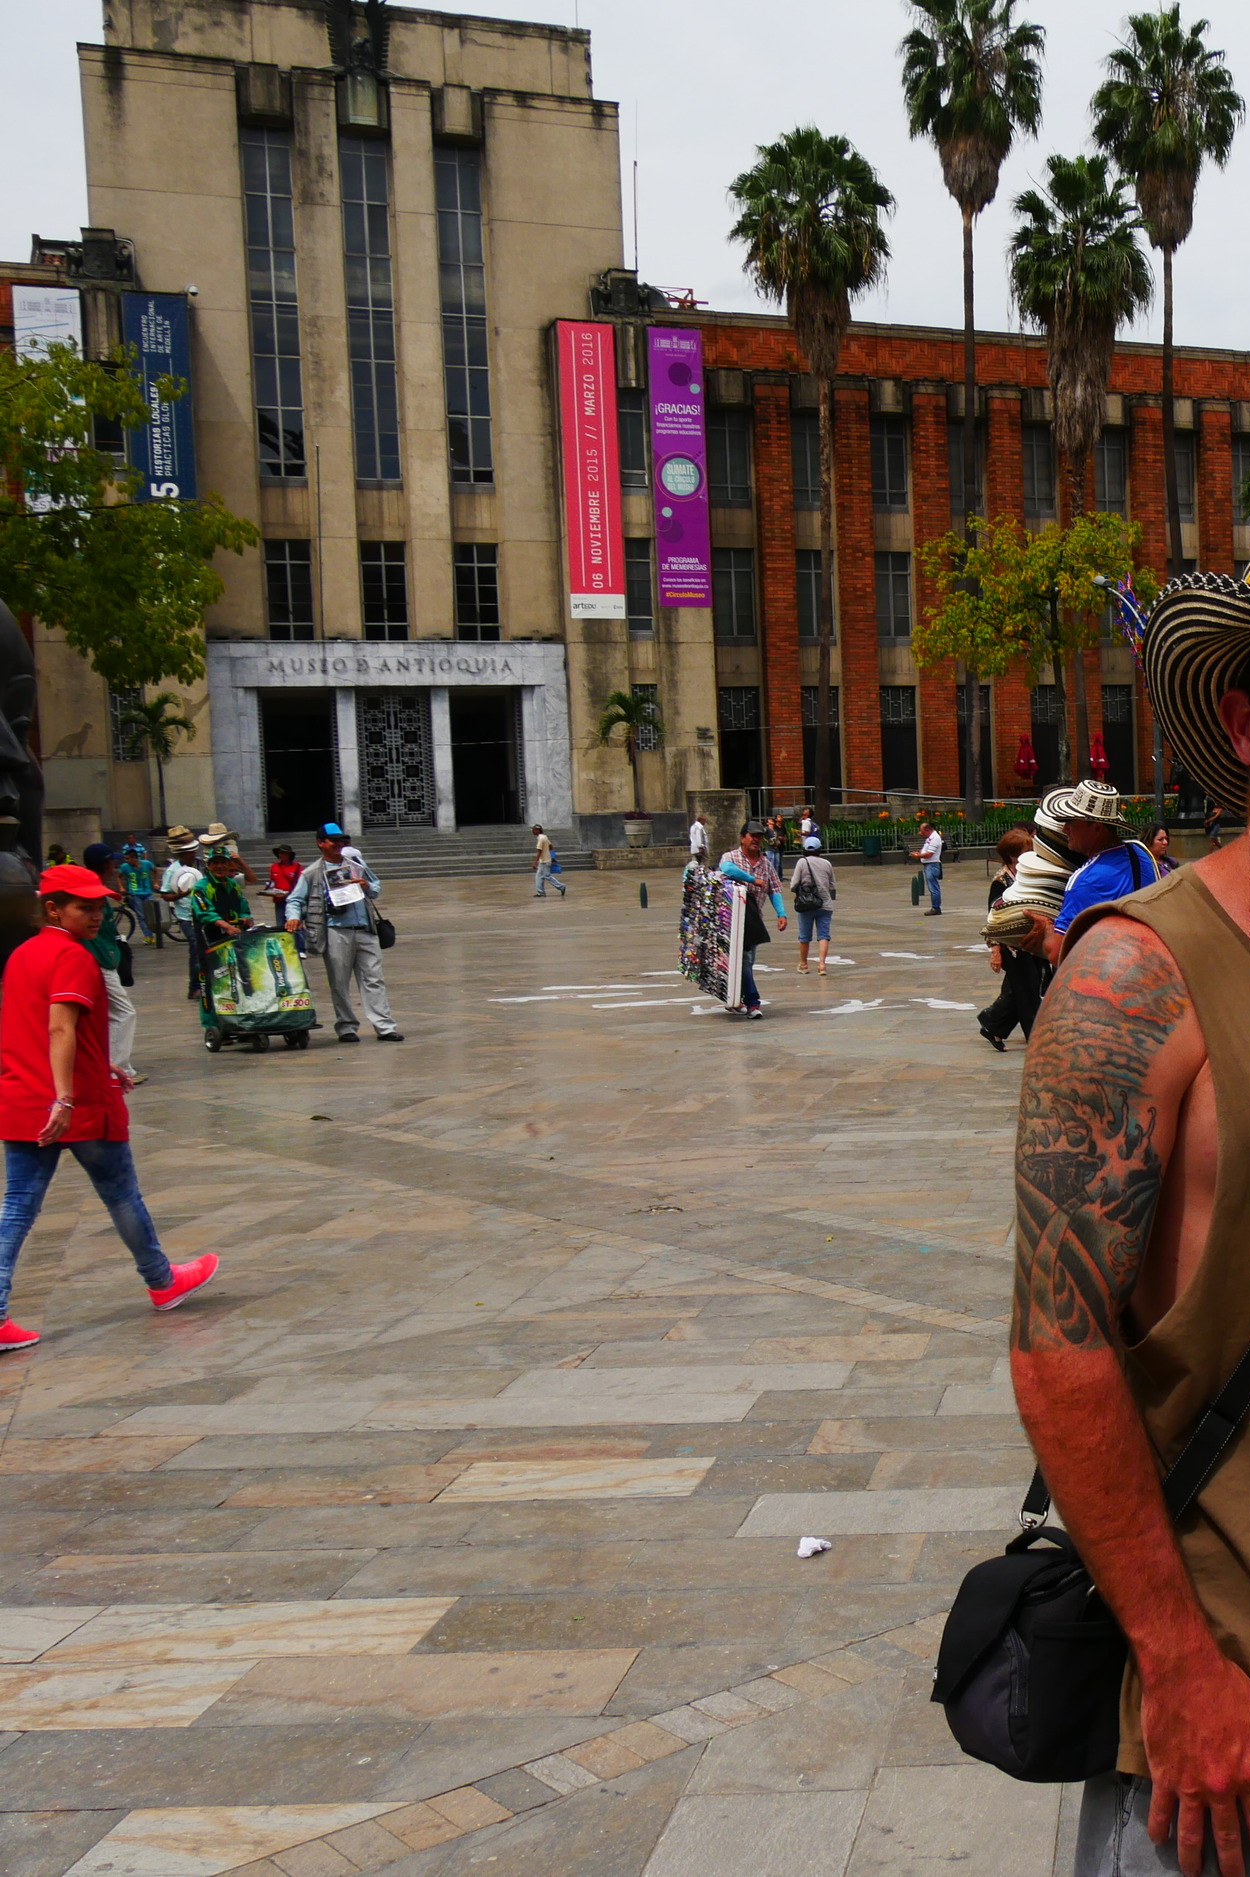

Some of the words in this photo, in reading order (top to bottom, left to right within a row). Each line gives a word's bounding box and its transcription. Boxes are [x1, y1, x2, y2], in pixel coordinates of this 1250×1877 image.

[581, 332, 594, 366] 2016
[583, 374, 596, 416] MARZO
[655, 402, 701, 415] ¡GRACIAS!
[152, 427, 164, 476] HISTORIAS
[586, 449, 599, 481] 2015
[588, 490, 603, 564] NOVIEMBRE
[592, 573, 604, 589] 06
[268, 657, 347, 675] MUSEO
[379, 657, 513, 675] ANTIOQUIA
